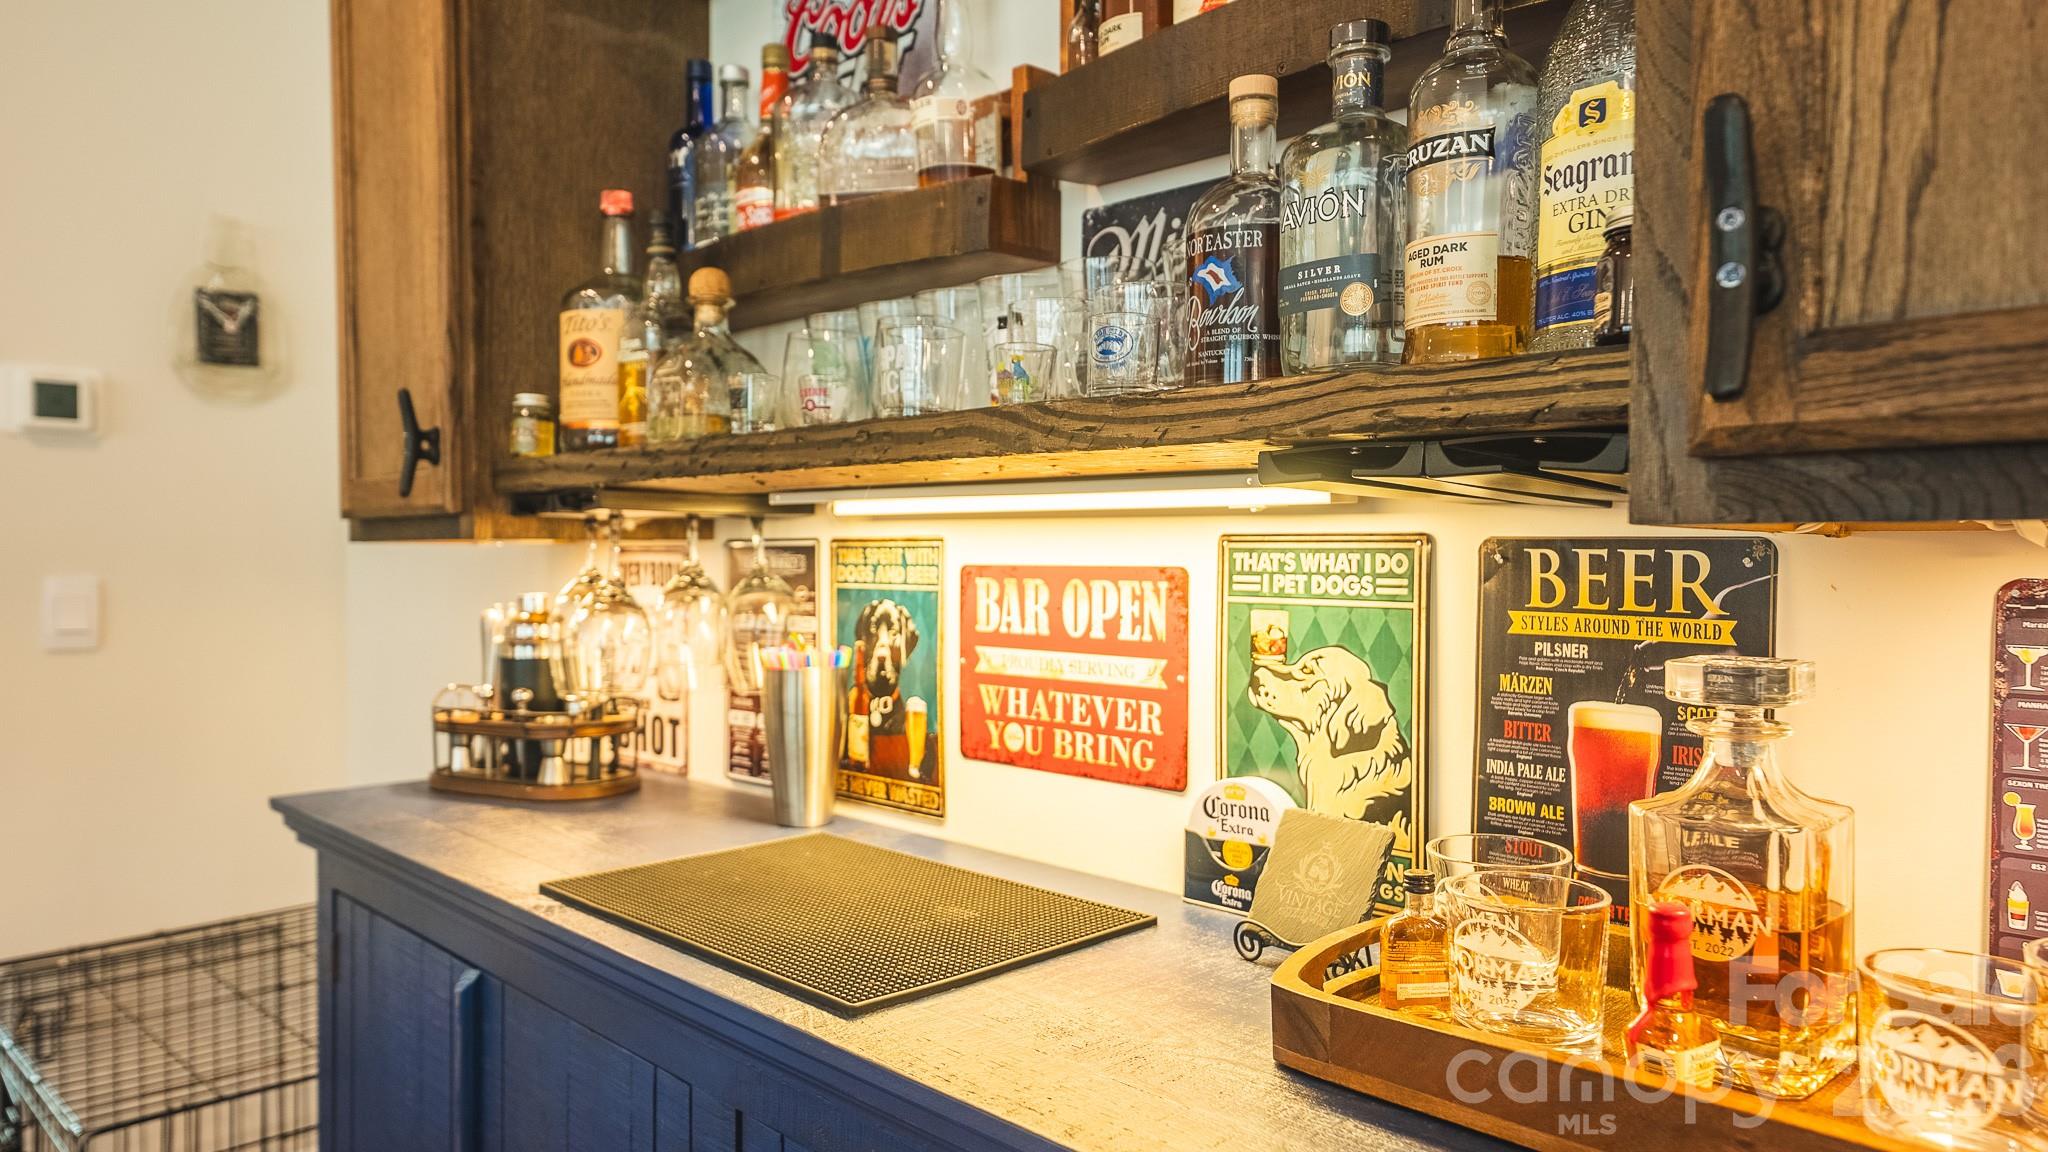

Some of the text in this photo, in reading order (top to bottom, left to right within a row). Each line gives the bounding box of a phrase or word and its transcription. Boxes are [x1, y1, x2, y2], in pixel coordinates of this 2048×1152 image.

[1407, 133, 1490, 167] RUZAN
[1280, 187, 1367, 234] AVIÓN
[1552, 186, 1634, 217] EXTRA DR
[1408, 241, 1468, 263] AGED DARK
[1420, 255, 1444, 269] RUM
[1297, 264, 1341, 280] SILVER
[1187, 287, 1259, 351] Bourbon
[1211, 327, 1231, 335] BLEND
[1201, 334, 1227, 343] STRAIGHT
[1229, 333, 1260, 341] BOURBON
[1232, 552, 1410, 575] THAT'S WHAT I DO
[1261, 574, 1375, 597] I PET DOGS
[1524, 548, 1730, 616] BEER
[974, 576, 1169, 643] BAR OPEN
[1521, 615, 1722, 641] STYLES AROUND THE WORLD
[1534, 641, 1589, 660] PILSNER
[1067, 658, 1136, 679] SERVING
[1499, 671, 1553, 695] MÄRZEN
[978, 683, 1164, 736] WHATEVER
[1504, 719, 1552, 743] BITTER
[985, 719, 1157, 773] YOU BRING
[1486, 758, 1566, 783] INDIA PALE ALE
[1203, 795, 1270, 823] Corona
[1488, 796, 1536, 817] BROWN
[1540, 803, 1566, 821] ALE
[1217, 818, 1254, 837] Extra
[1505, 837, 1543, 858] STOUT
[1211, 879, 1252, 901] Corona
[1502, 877, 1531, 893] WHEAT
[1279, 886, 1343, 918] VINTAGE
[1705, 943, 1734, 957] 2022
